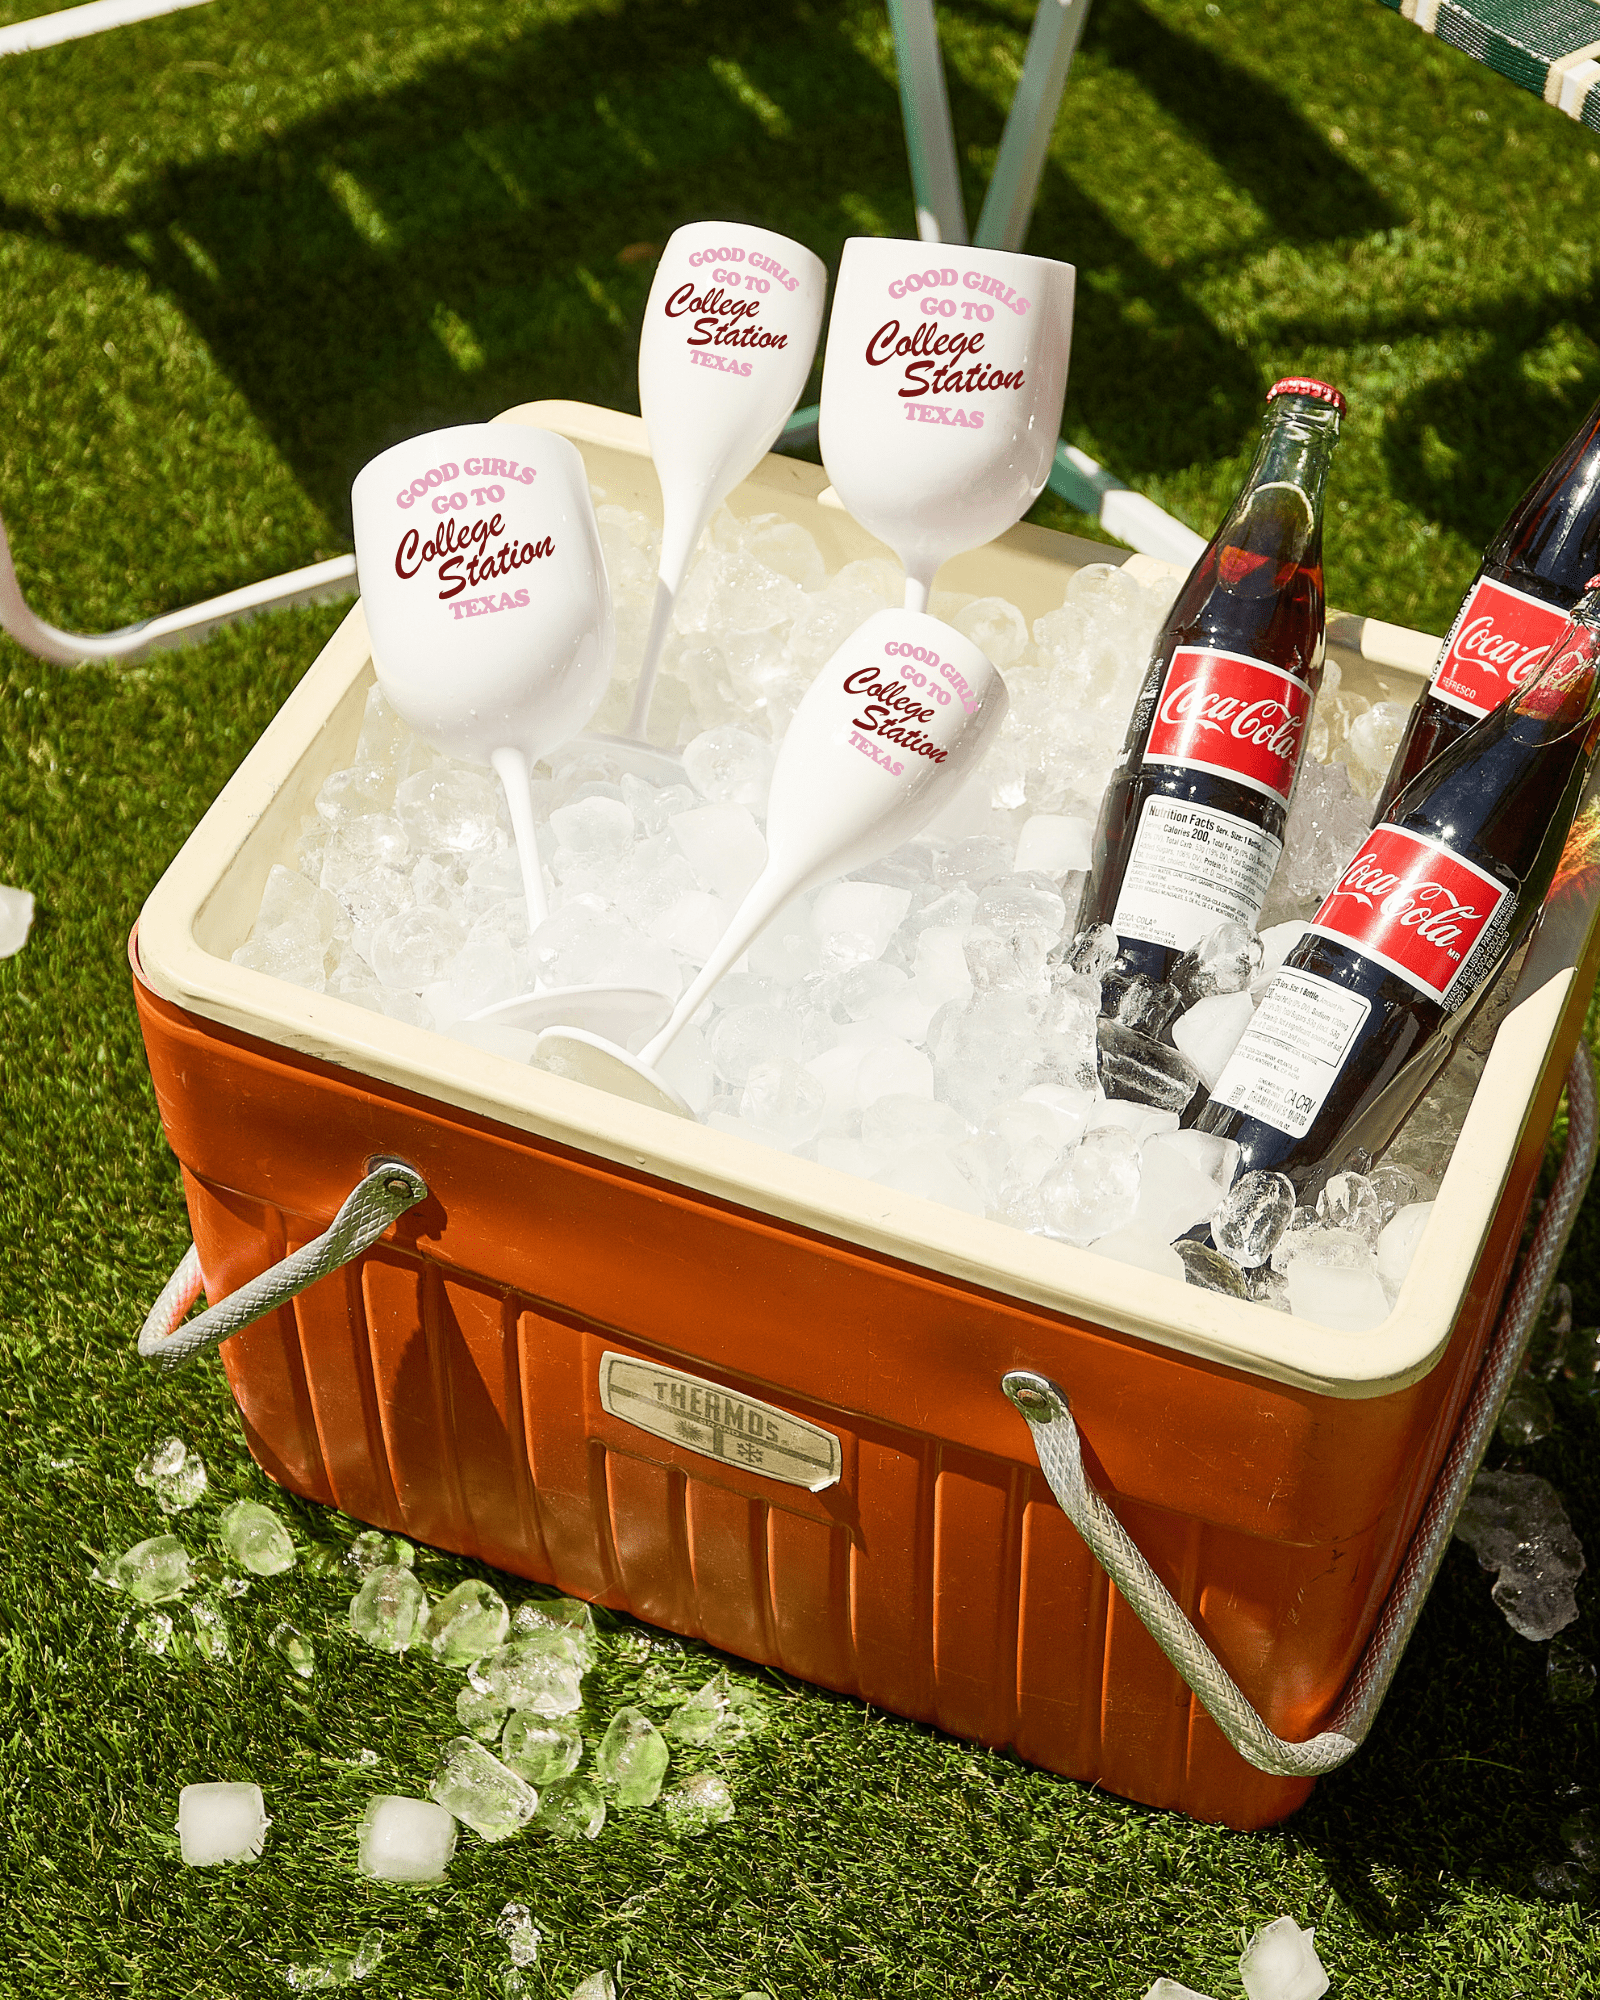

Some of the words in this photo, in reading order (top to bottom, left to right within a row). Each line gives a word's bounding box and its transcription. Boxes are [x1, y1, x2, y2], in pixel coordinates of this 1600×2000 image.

[689, 247, 745, 267] GOOD
[747, 252, 800, 293] GIRLS
[712, 268, 741, 286] GO
[745, 275, 770, 293] TO
[664, 282, 761, 324] College
[888, 269, 958, 299] GOOD
[963, 271, 1031, 315] GIRLS
[920, 297, 957, 317] GO
[961, 302, 994, 322] TO
[687, 318, 787, 349] Station
[866, 320, 984, 368] College
[690, 349, 753, 377] TEXAS
[898, 360, 1025, 397] Station
[904, 402, 984, 429] TEXAS
[396, 463, 459, 509] GOOD
[464, 458, 536, 485] GIRLS
[432, 492, 468, 514] GO
[471, 485, 505, 506] TO
[395, 513, 506, 579] College
[439, 536, 555, 599] Station
[449, 589, 530, 620] TEXAS
[843, 668, 934, 723] College
[885, 642, 940, 667] GOOD
[940, 663, 979, 714] GIRLS
[900, 665, 927, 687] GO
[927, 682, 951, 705] TO
[1442, 676, 1476, 698] REFRESCO
[852, 705, 948, 763] Station
[1160, 677, 1302, 759] Coca-Cola
[848, 731, 904, 776] TEXAS
[1148, 805, 1189, 823] Nutrition
[1189, 813, 1215, 830] Facts
[1215, 825, 1230, 836] Serv.
[1230, 830, 1243, 841] Size:
[1162, 823, 1191, 837] Calories
[1190, 827, 1212, 845] 200,
[1212, 838, 1224, 848] Total
[1224, 842, 1232, 851] Fat
[1166, 836, 1179, 845] Total
[1204, 857, 1221, 869] Protein
[1441, 982, 1462, 1010] ENVASE
[1457, 945, 1485, 984] EXCLUSIVO
[1480, 926, 1496, 947] PARA
[1491, 891, 1516, 928] REFRESCO
[1446, 947, 1461, 962] MR
[1464, 972, 1477, 988] THE
[1473, 933, 1501, 974] COCA-COLA
[1470, 967, 1488, 992] HECHO
[1485, 957, 1495, 969] EN
[1491, 930, 1510, 958] MEXICO
[1302, 988, 1320, 1002] Bottle,
[1311, 1007, 1331, 1021] Sodium
[1331, 1017, 1349, 1032] 120mg
[1330, 1028, 1340, 1040] 53g
[1282, 1088, 1298, 1106] CA
[1294, 1093, 1316, 1115] CRV
[654, 1382, 780, 1441] THERMOS
